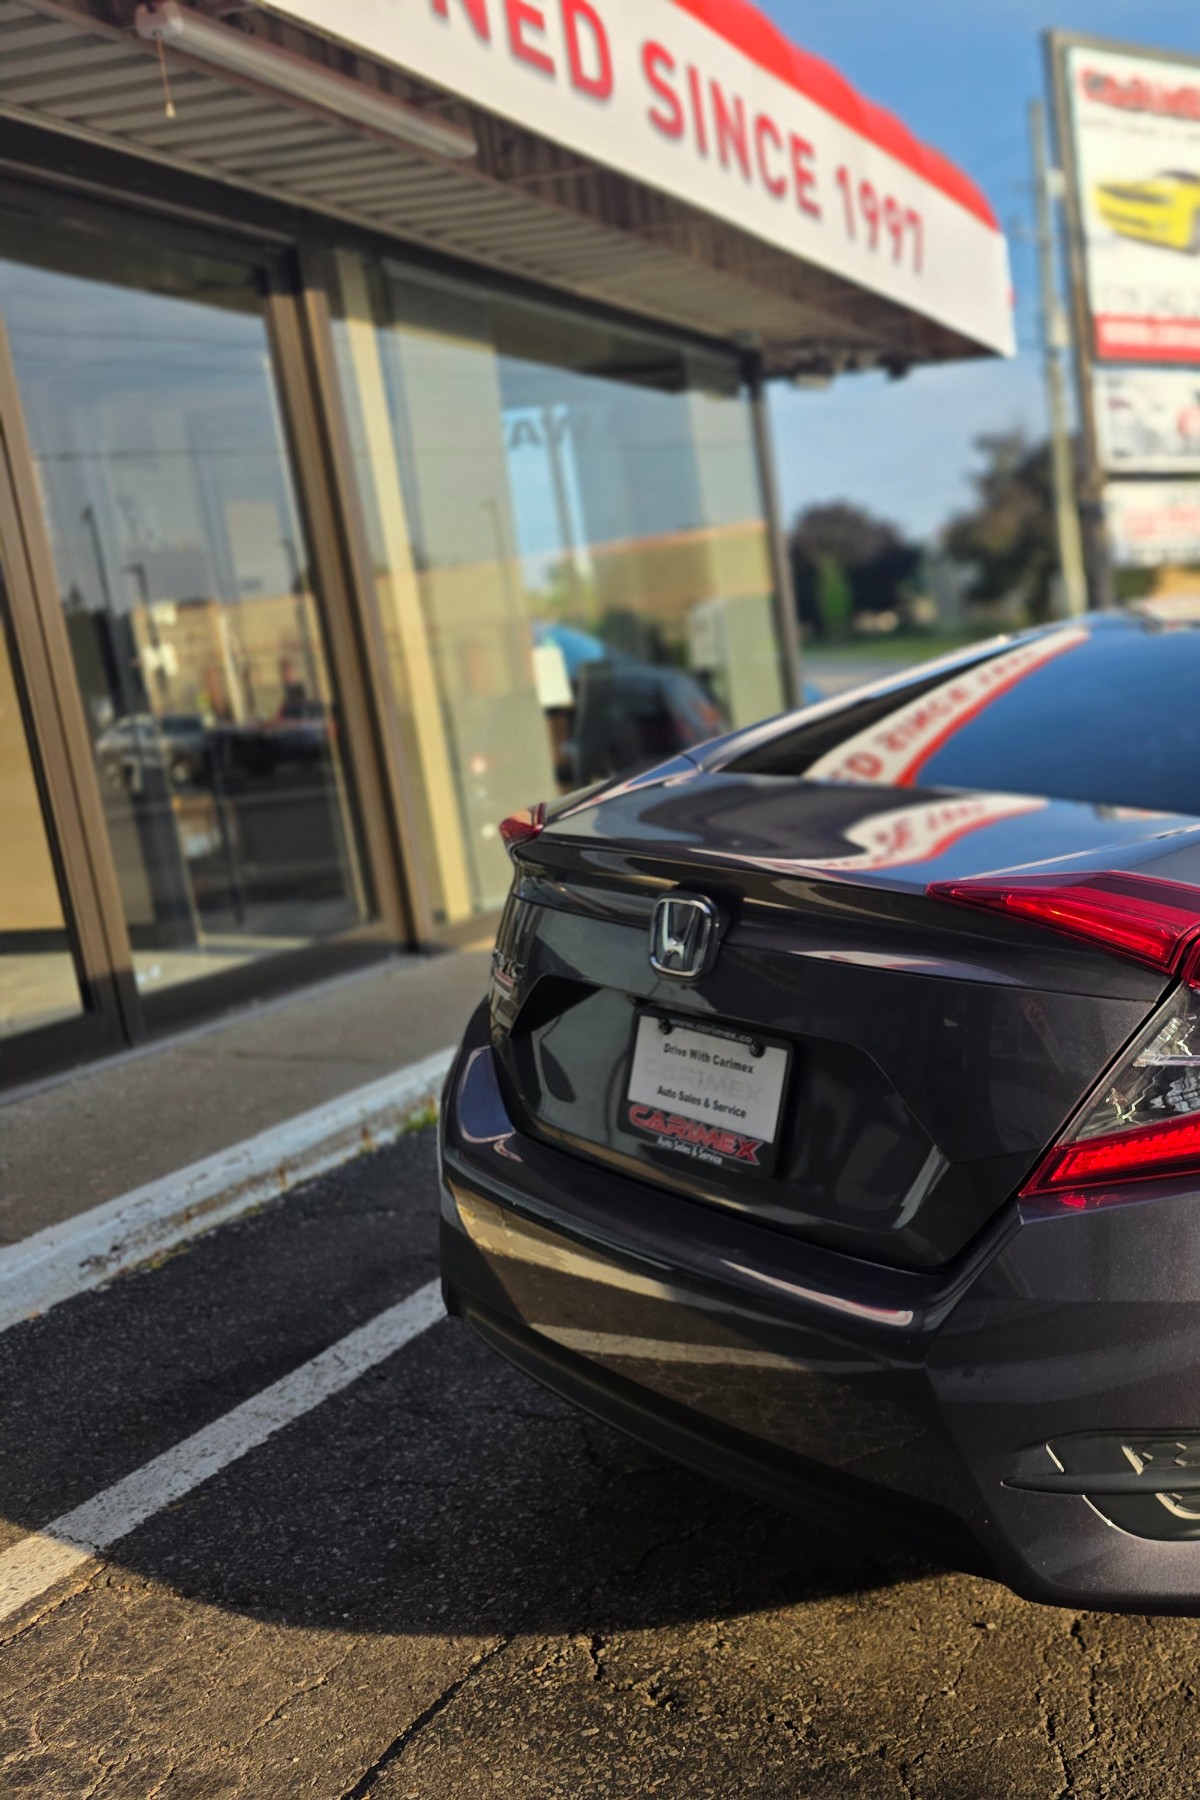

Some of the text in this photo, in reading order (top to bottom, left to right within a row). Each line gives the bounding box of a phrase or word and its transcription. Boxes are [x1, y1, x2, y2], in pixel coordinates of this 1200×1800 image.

[641, 40, 819, 220] SINCE
[836, 165, 923, 273] 1997
[663, 1042, 754, 1074] Drive With Carimex
[656, 1085, 747, 1119] Auto Sales & Service
[628, 1103, 764, 1166] CARIMEX
[656, 1136, 723, 1166] Auto Sales & Service
